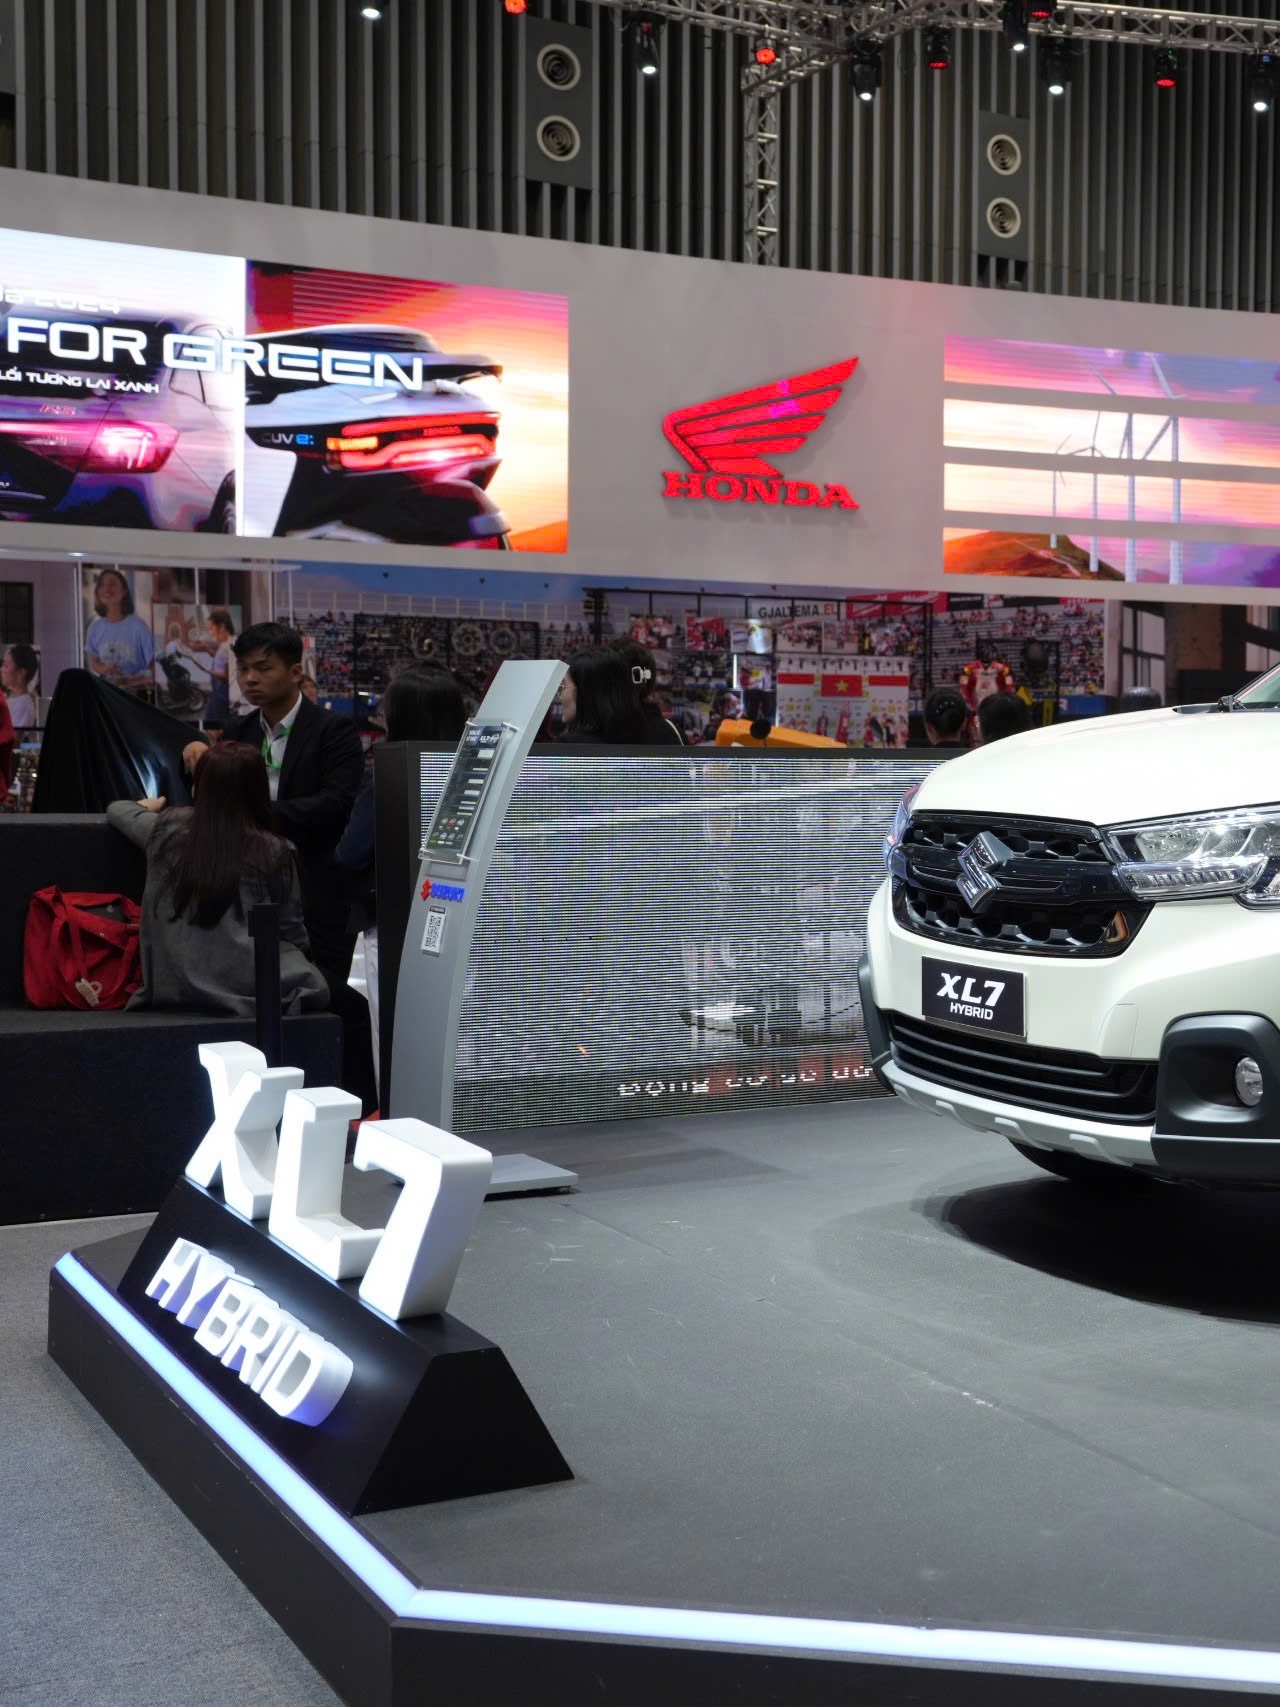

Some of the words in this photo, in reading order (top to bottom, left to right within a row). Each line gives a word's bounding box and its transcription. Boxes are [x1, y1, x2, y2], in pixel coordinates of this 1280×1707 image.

[7, 316, 148, 366] FOR
[163, 333, 423, 391] GREEN
[86, 378, 110, 390] LAI
[113, 378, 160, 394] XANH
[661, 470, 861, 511] HONDA
[936, 972, 1006, 1007] XL7
[949, 1002, 994, 1021] HYBRID
[184, 1041, 493, 1321] XL7
[144, 1237, 354, 1428] HYBRID
